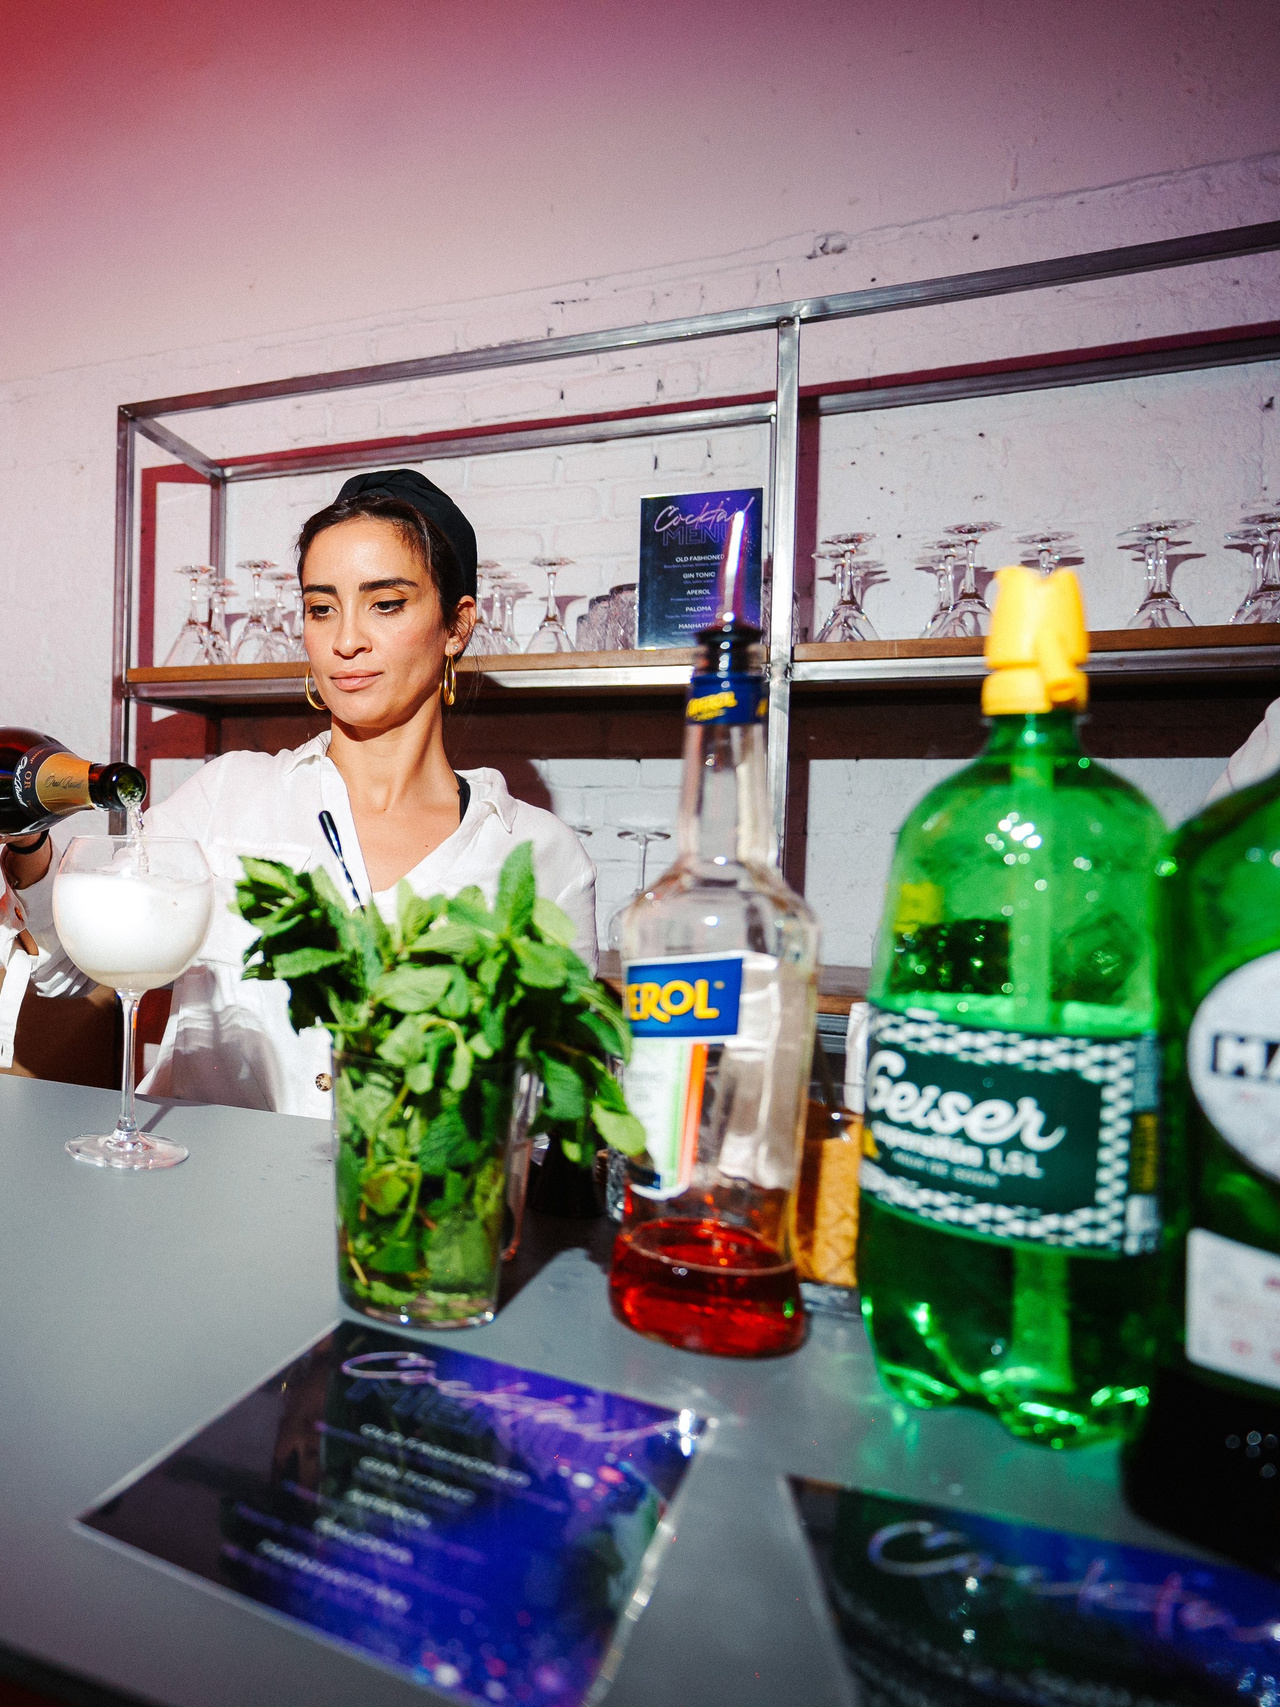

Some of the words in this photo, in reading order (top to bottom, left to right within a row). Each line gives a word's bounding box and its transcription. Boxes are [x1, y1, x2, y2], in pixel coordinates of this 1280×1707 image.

[685, 605, 712, 613] PALOMA
[24, 770, 32, 789] OR
[627, 978, 720, 1024] EROL
[867, 1050, 1067, 1152] Geiser
